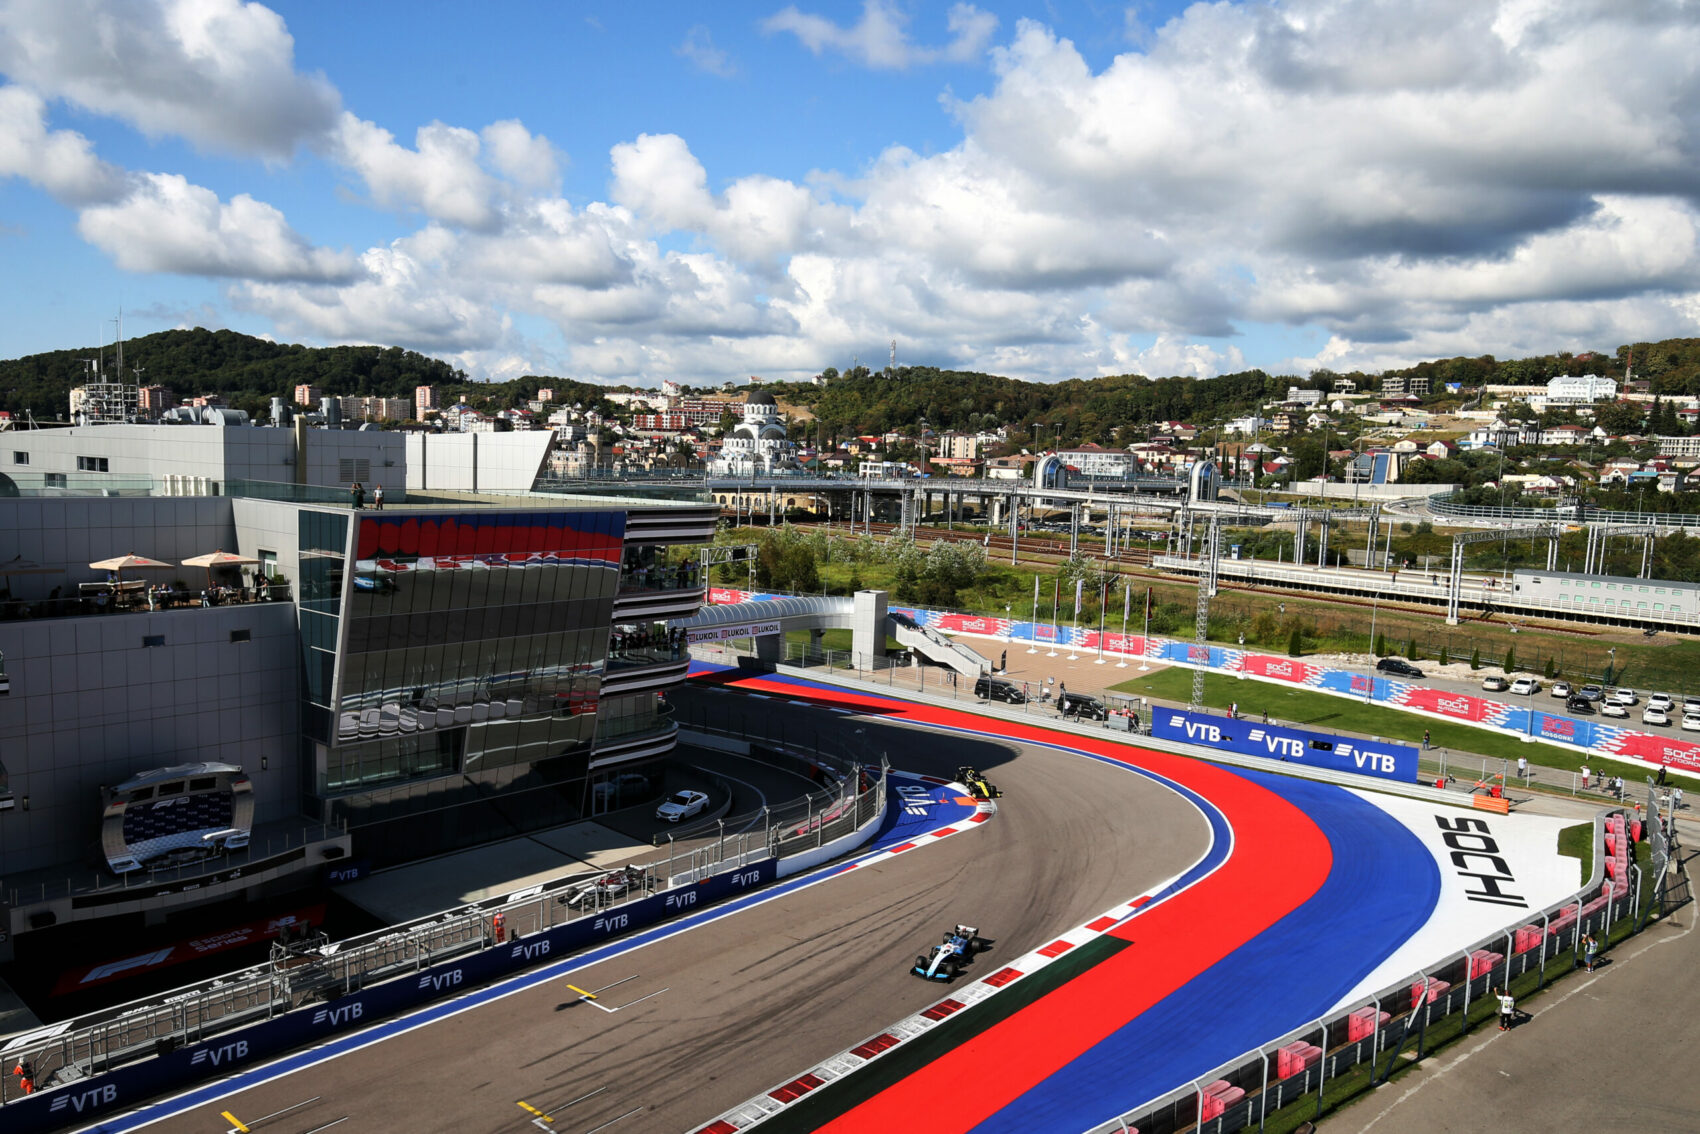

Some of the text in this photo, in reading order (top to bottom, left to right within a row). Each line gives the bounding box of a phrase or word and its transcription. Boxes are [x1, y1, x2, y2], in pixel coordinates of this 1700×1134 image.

[695, 632, 718, 641] LUKOIL
[727, 628, 749, 637] LUKOIL
[758, 624, 779, 633] LUKOIL
[1266, 663, 1293, 673] SOCHI
[1437, 698, 1469, 711] SOCHI
[1185, 721, 1220, 743] VTB
[1541, 731, 1574, 742] ROSGONKI
[1265, 736, 1304, 757] VTB
[1353, 750, 1395, 773] VTB
[895, 785, 936, 807] VTB
[1434, 815, 1529, 908] SOCHI
[339, 868, 358, 880] VTB
[740, 870, 759, 887] VTB
[675, 891, 697, 908] VTB
[605, 914, 628, 932] VTB
[524, 940, 550, 960] VTB
[432, 969, 463, 990] VTB
[328, 1002, 363, 1026] VTB
[209, 1040, 248, 1066] VTB
[72, 1084, 117, 1112] VTB
